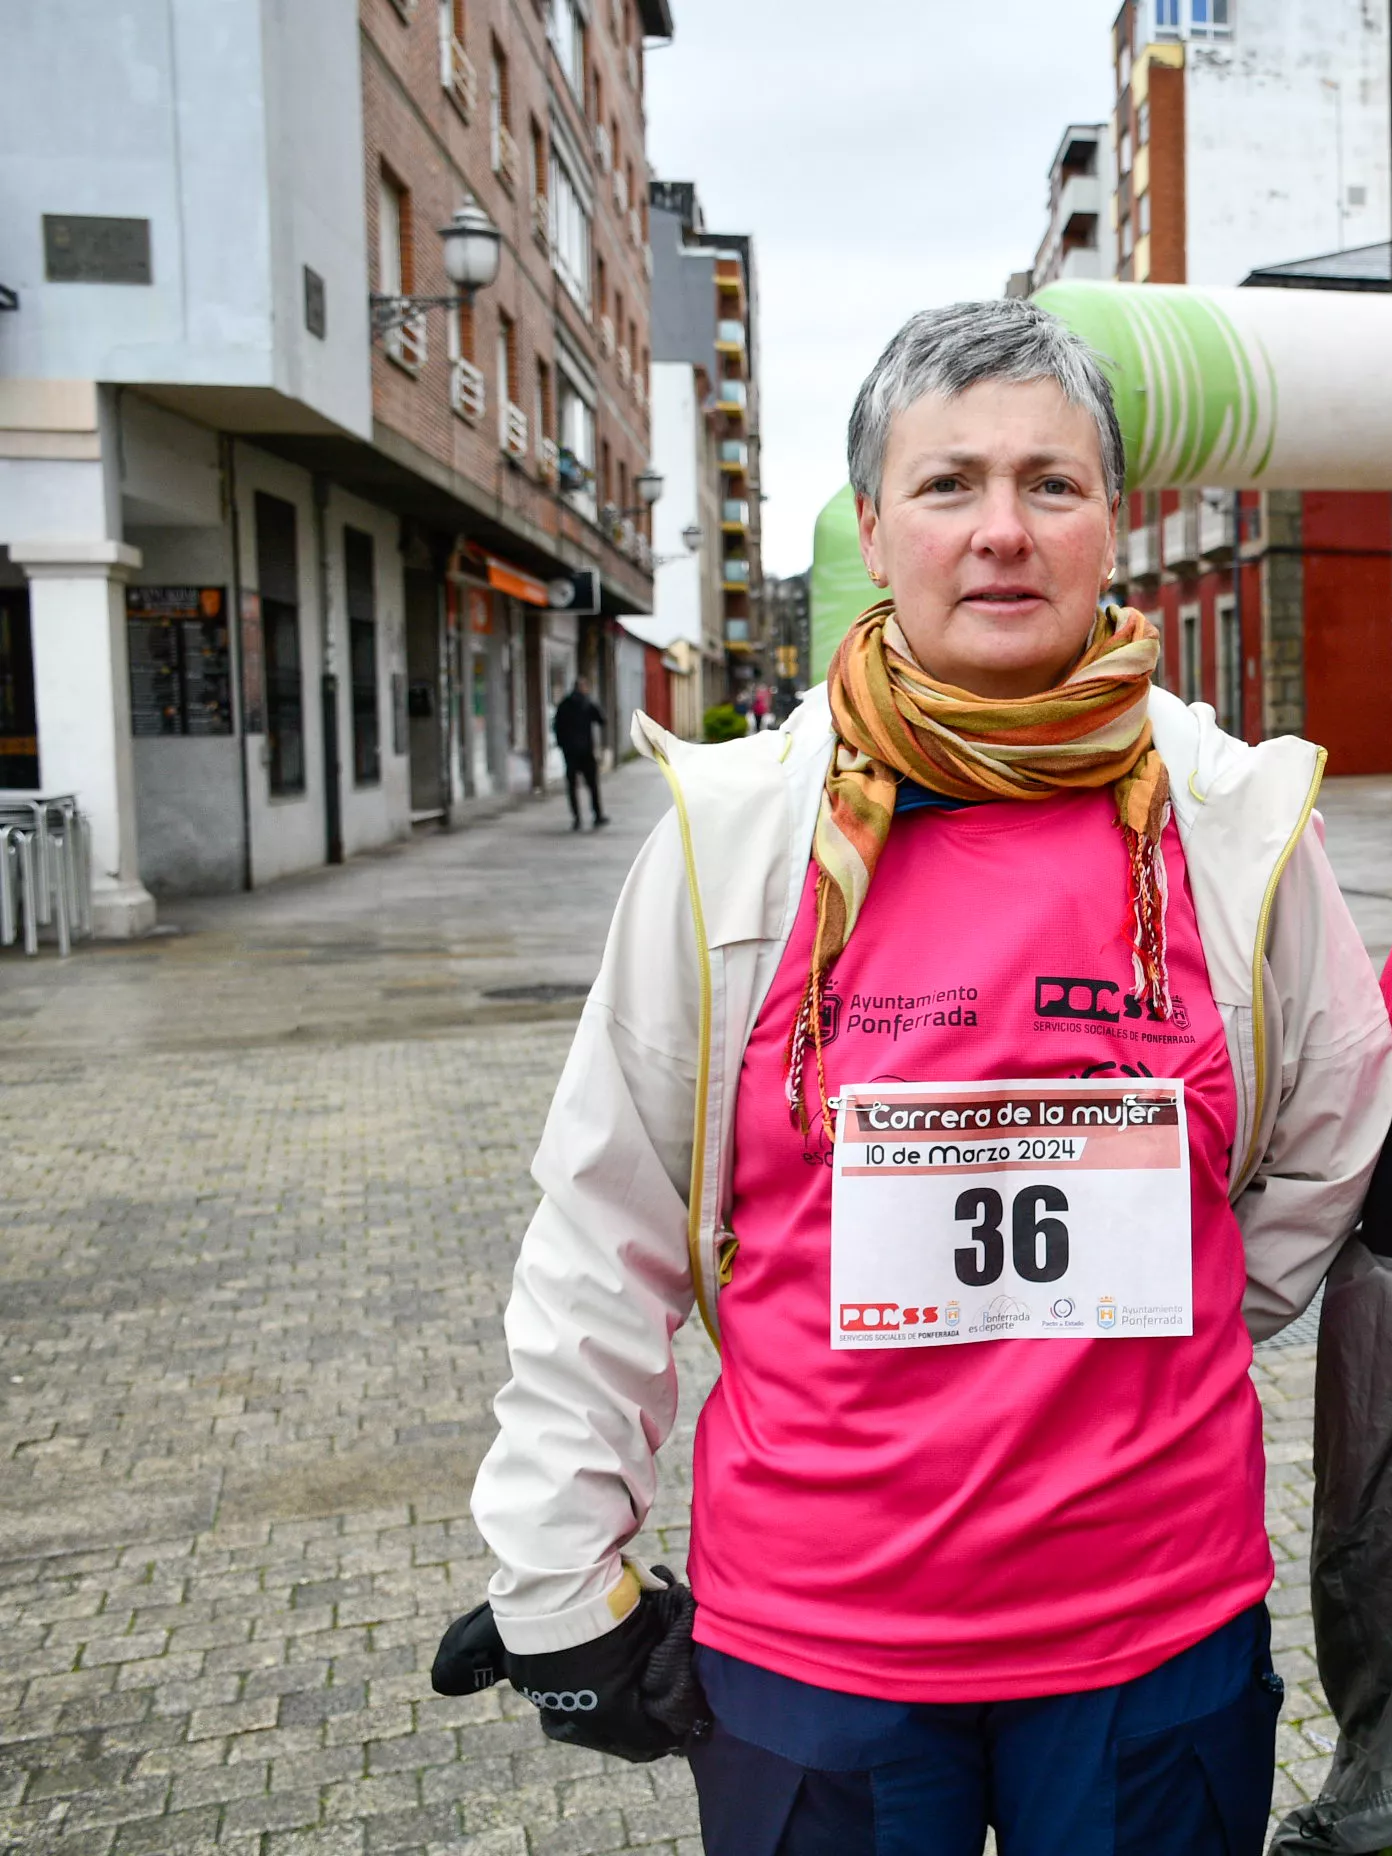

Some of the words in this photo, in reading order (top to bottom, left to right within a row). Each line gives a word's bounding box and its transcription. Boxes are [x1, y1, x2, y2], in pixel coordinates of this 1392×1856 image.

[850, 985, 978, 1012] Ayuntamiento
[847, 1005, 978, 1041] Ponferrada
[1033, 1021, 1082, 1033] SERVICIOS
[1084, 1024, 1128, 1039] SOCIALES
[1129, 1030, 1139, 1041] DE
[1141, 1033, 1196, 1044] PONFERRADA
[868, 1103, 991, 1130] Carrera
[996, 1102, 1031, 1126] de
[1039, 1100, 1064, 1125] la
[1072, 1100, 1161, 1132] mujer
[866, 1144, 884, 1165] 10
[892, 1147, 920, 1165] de
[928, 1145, 1010, 1164] Marzo
[1017, 1139, 1076, 1161] 2024
[954, 1184, 1069, 1287] 36
[983, 1311, 1030, 1324] Ponferrada
[1121, 1305, 1183, 1314] Ayuntamiento
[968, 1326, 978, 1334] es
[979, 1320, 1015, 1333] deporte
[1064, 1319, 1085, 1327] Estado
[1121, 1314, 1183, 1328] Ponferrada
[839, 1334, 873, 1342] SERVICIOS
[875, 1333, 906, 1341] SOCIALES
[908, 1332, 917, 1340] DE
[918, 1330, 960, 1339] PONFERRADA
